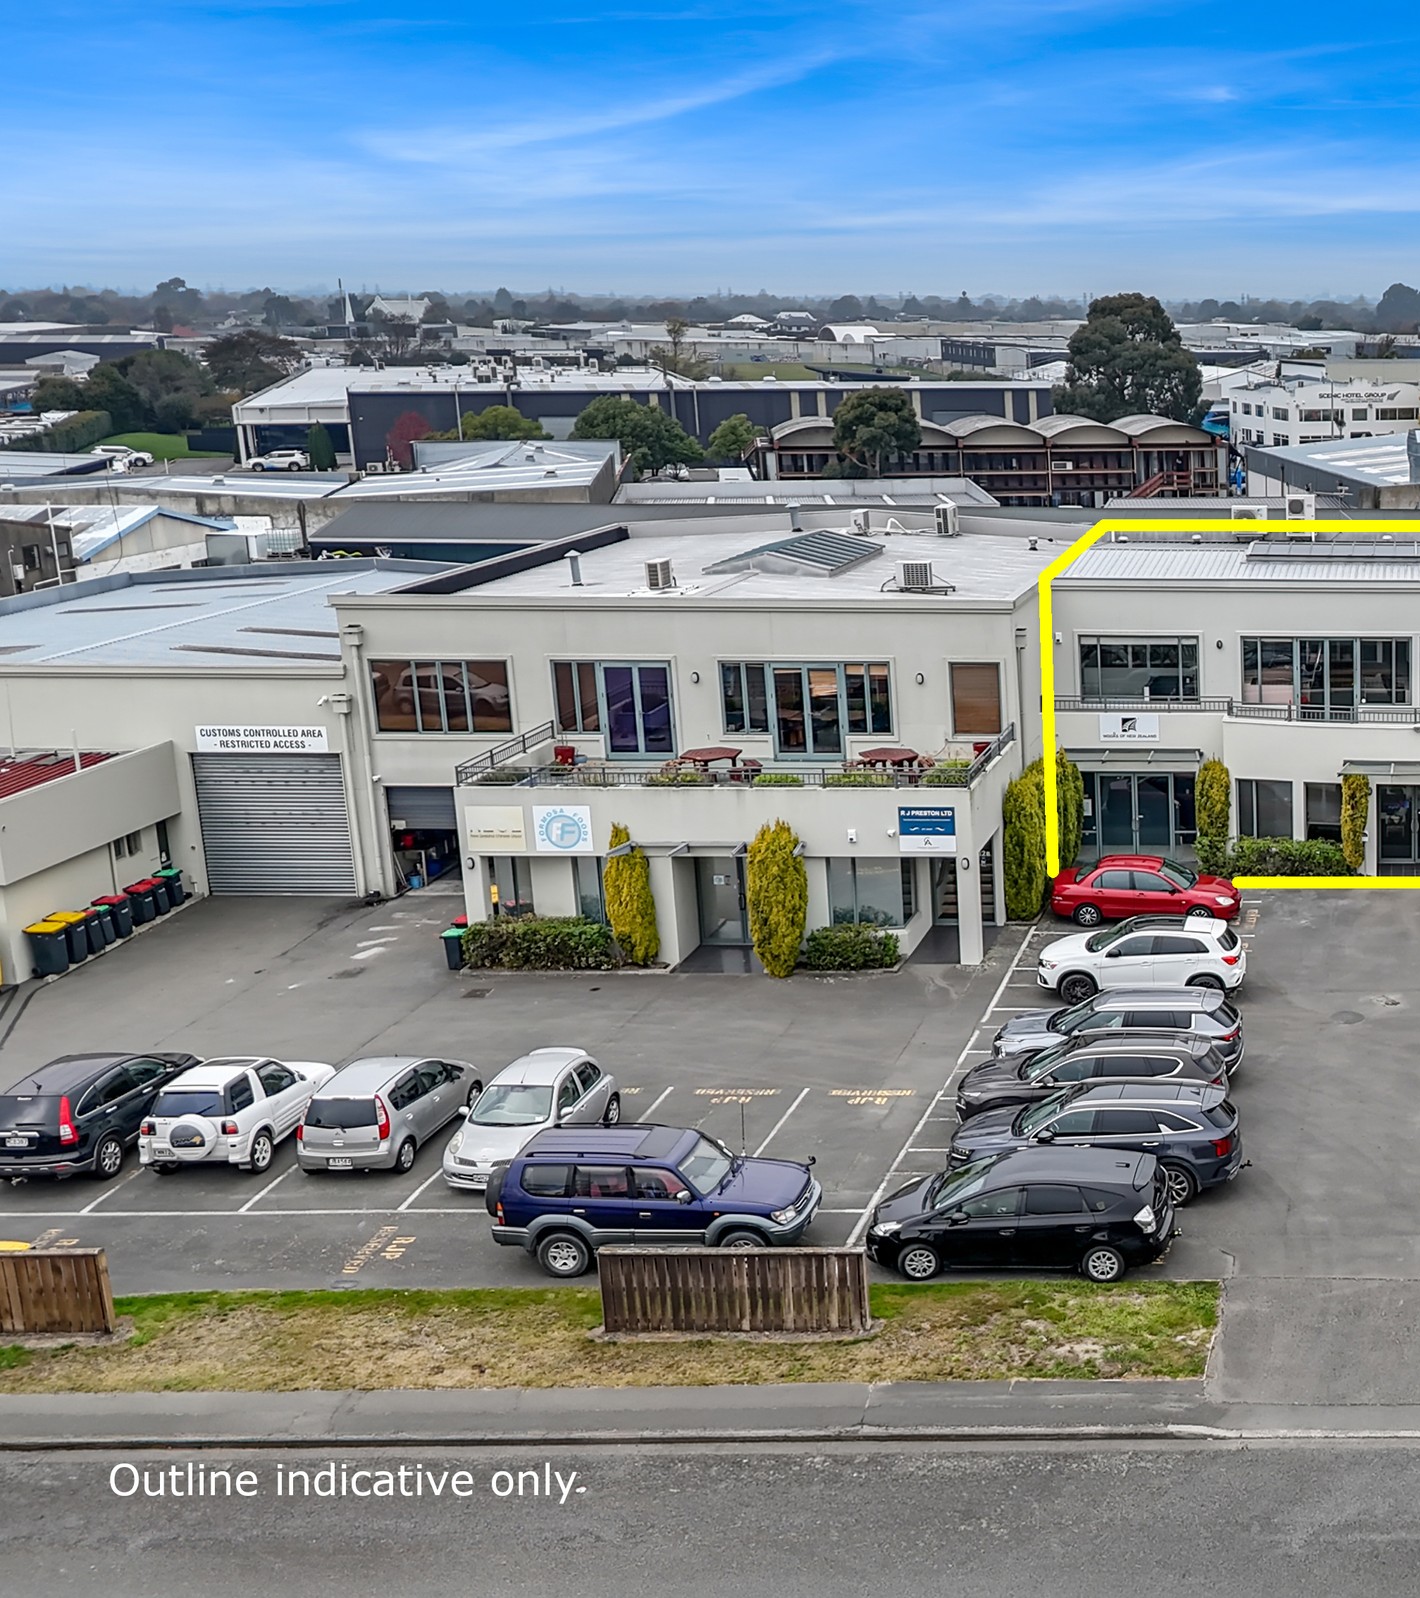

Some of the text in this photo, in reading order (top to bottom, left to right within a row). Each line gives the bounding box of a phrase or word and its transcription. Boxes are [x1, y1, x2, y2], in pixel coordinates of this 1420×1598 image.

[200, 728, 323, 738] CUSTOMS CONTROLLED AREA
[220, 740, 271, 748] RESTRICTED
[273, 740, 306, 749] ACCESS
[538, 807, 588, 842] FORMOSA FOODS
